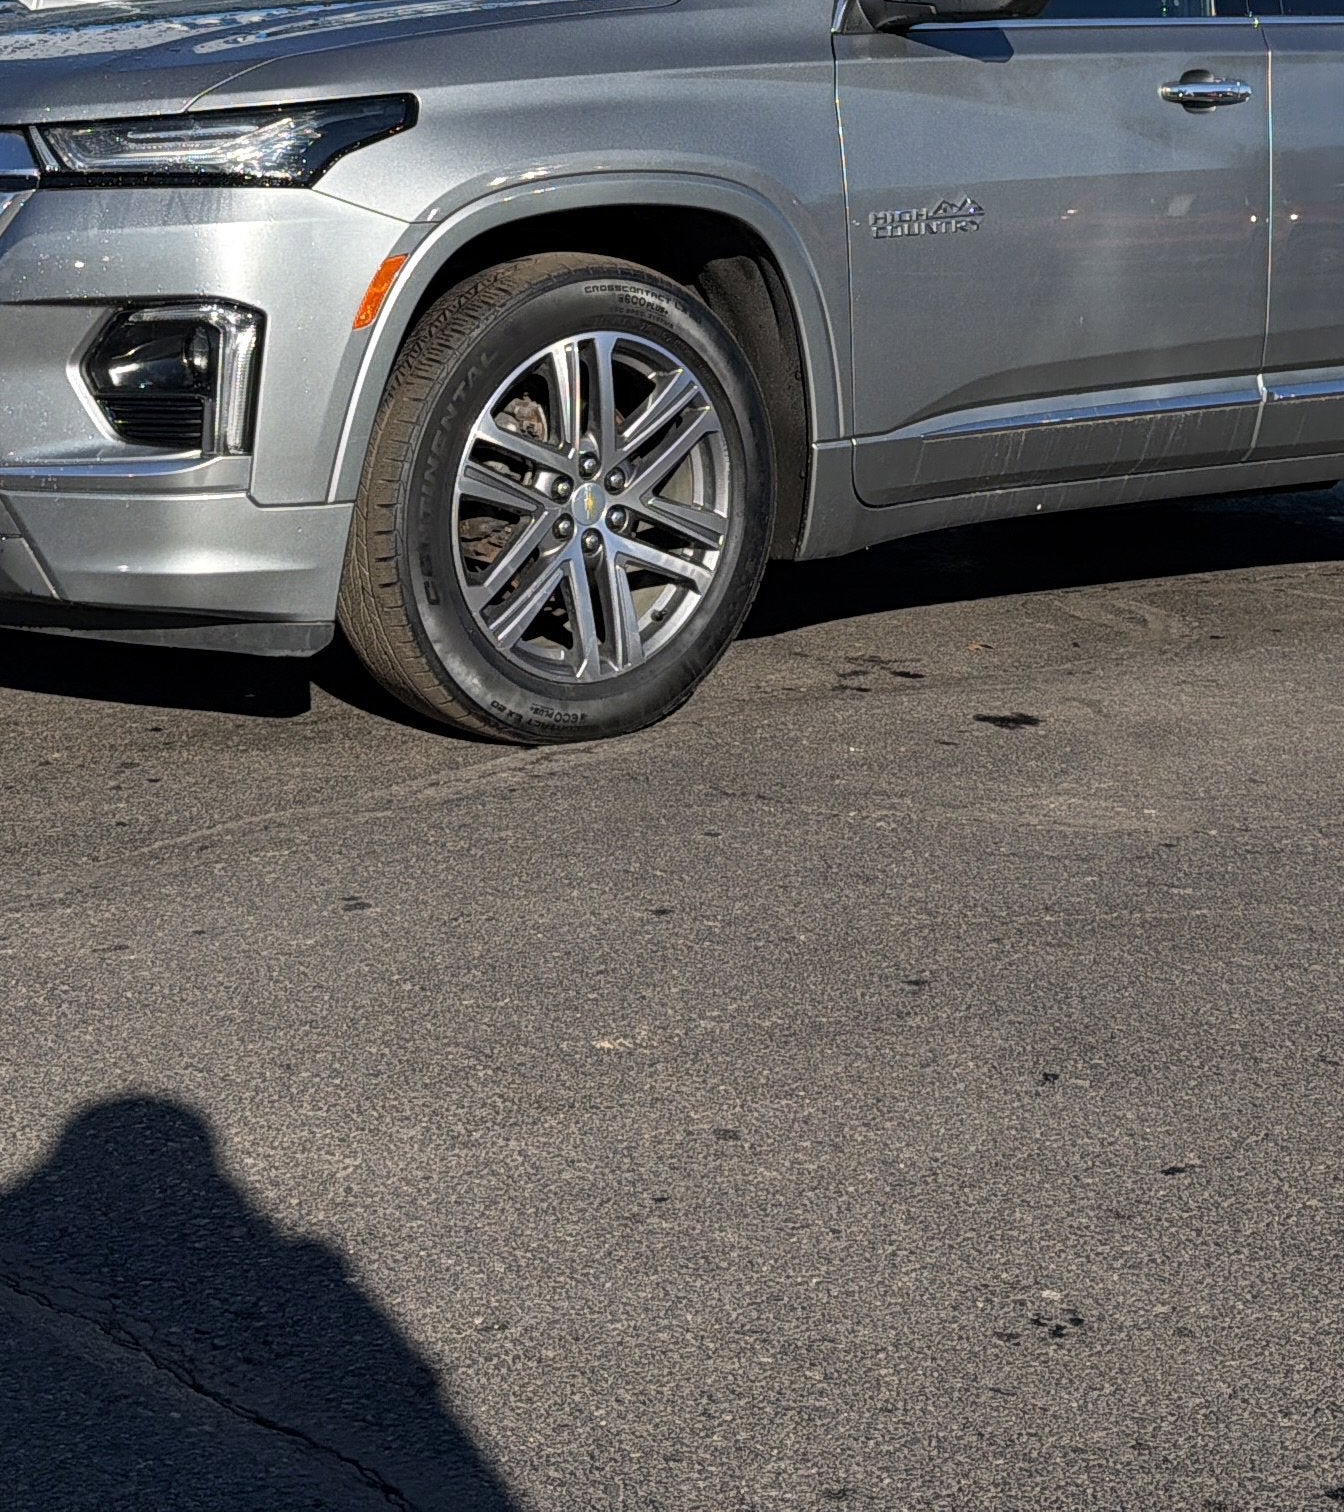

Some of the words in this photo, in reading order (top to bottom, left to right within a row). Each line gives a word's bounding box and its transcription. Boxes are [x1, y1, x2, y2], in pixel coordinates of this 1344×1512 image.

[869, 208, 929, 226] HIGH
[871, 220, 980, 238] COUNTRY
[418, 350, 499, 605] COTINENTAL
